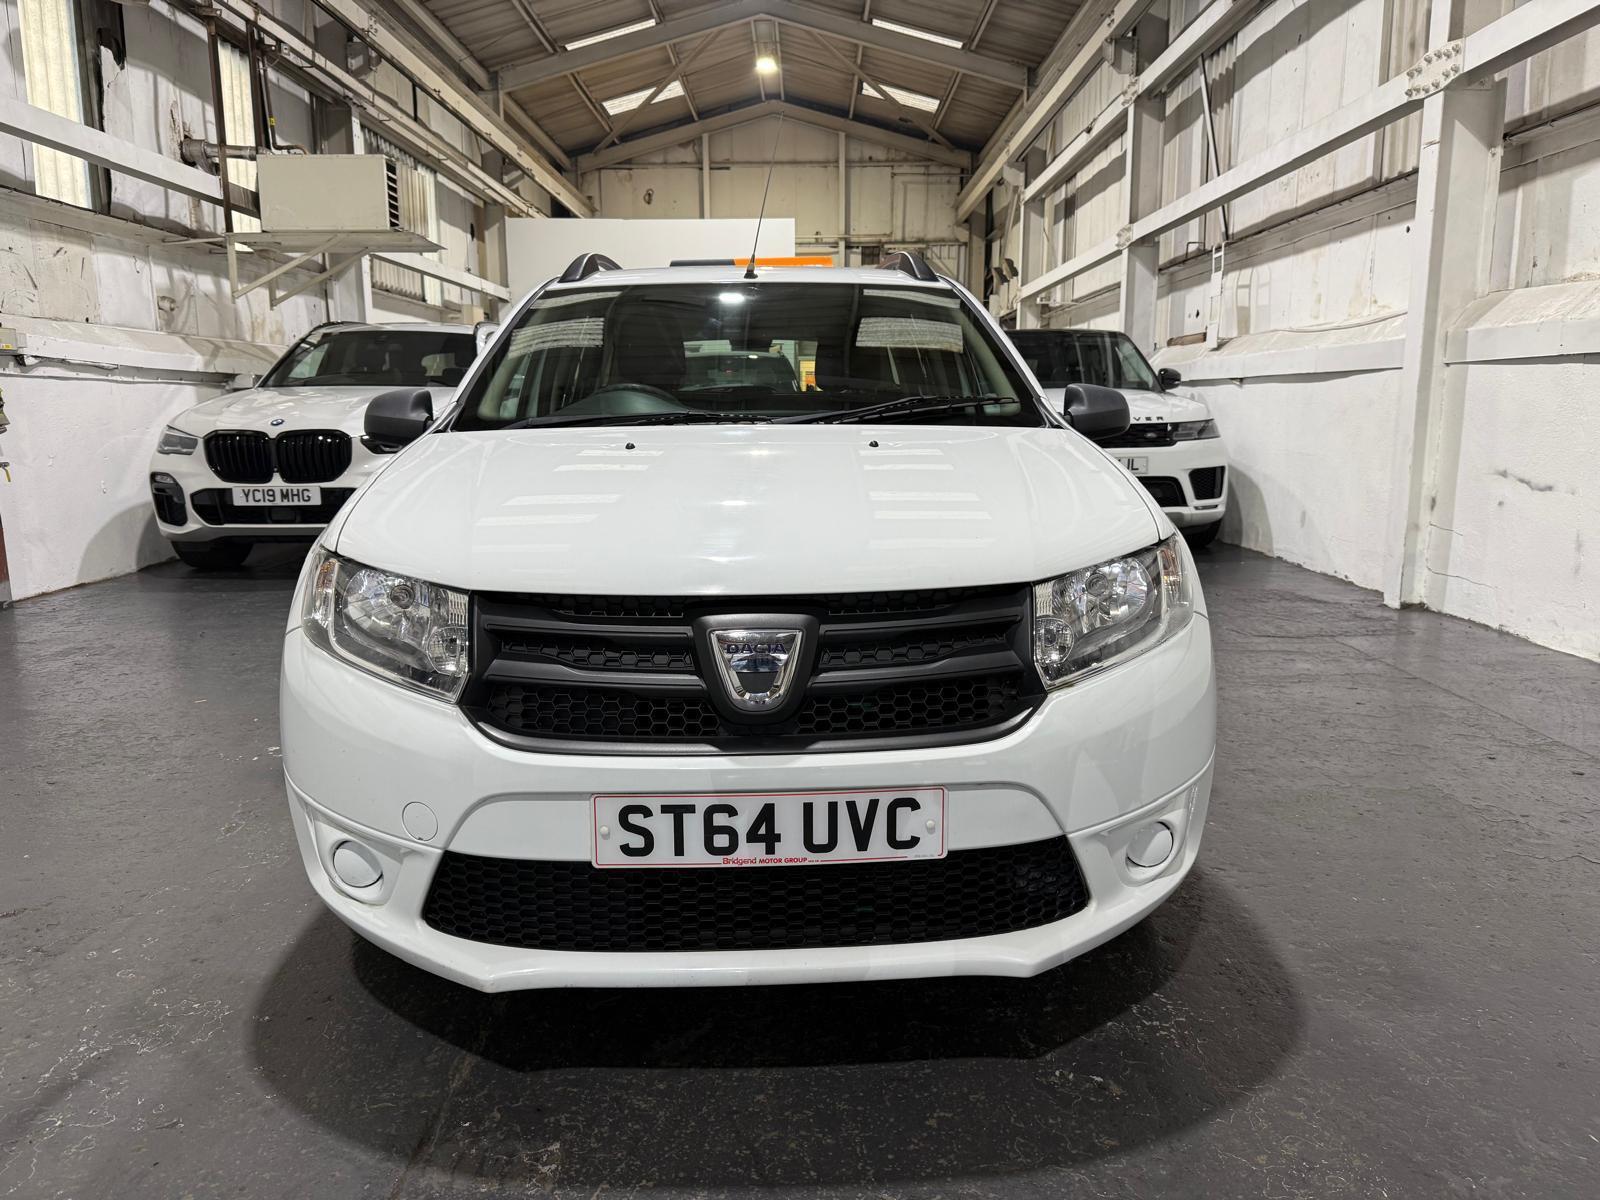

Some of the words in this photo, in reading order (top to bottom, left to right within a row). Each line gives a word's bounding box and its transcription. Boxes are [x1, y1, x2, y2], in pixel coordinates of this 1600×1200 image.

[242, 488, 276, 503] YC19
[281, 488, 311, 503] MHG
[726, 643, 787, 654] DACIA
[618, 802, 781, 857] ST64
[802, 797, 921, 854] UVC
[722, 857, 757, 866] Bridgend
